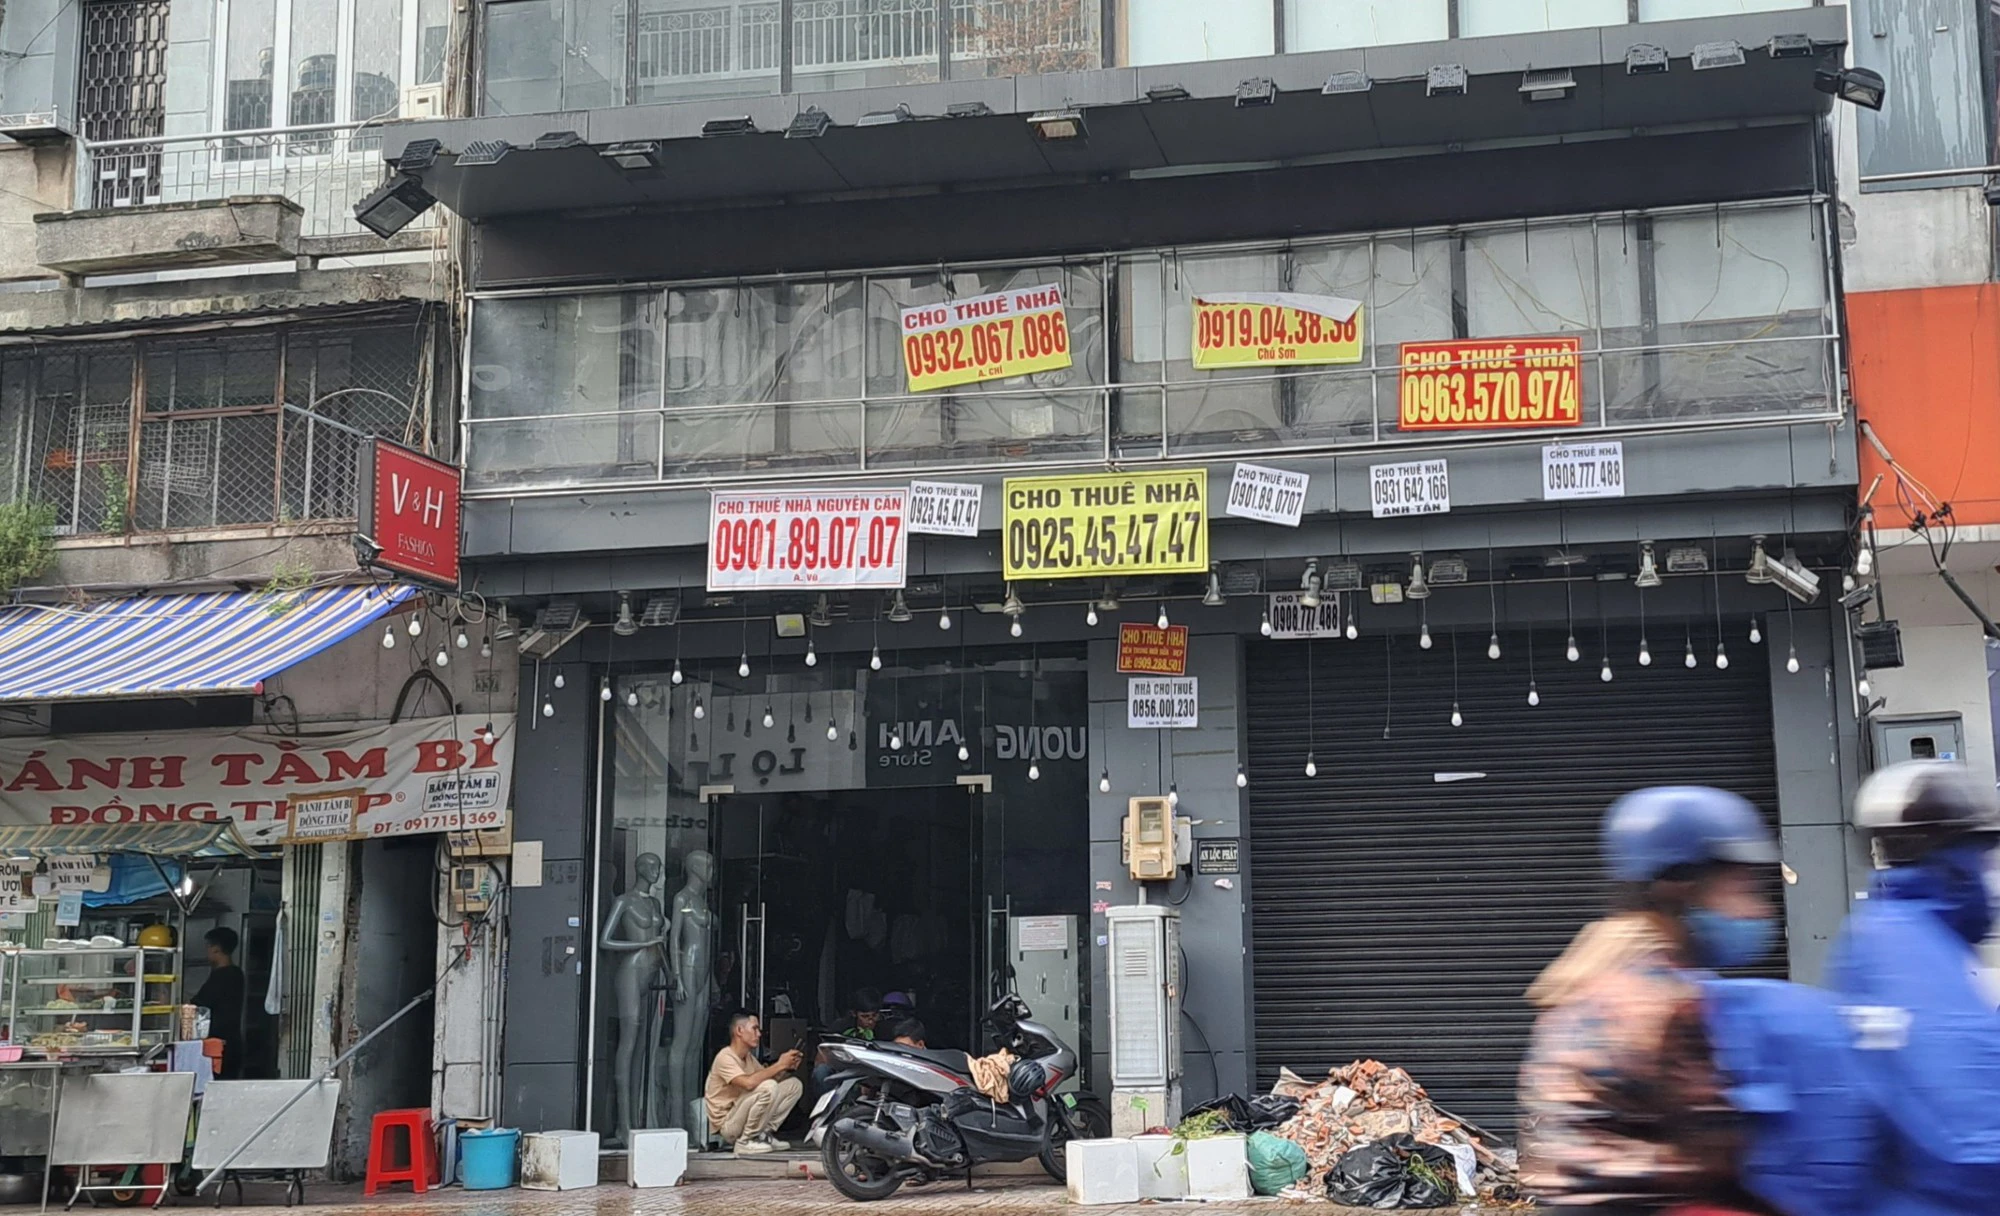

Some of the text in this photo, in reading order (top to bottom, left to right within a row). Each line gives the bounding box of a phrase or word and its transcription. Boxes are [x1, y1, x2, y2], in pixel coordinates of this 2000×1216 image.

[905, 285, 1062, 330] CHO THUÊ NHÀ
[906, 311, 1067, 377] 0932.067.086
[1278, 347, 1296, 359] Sơn
[1405, 343, 1575, 373] CHO THUÊ NHÀ
[1405, 370, 1576, 423] 0963.570.974
[1548, 445, 1619, 459] CHO THUÊ NHÀ
[1237, 468, 1303, 489] CHO THUÊ NHÀ
[1375, 462, 1445, 478] CHO THUÊ NHÀ
[1548, 460, 1621, 490] 0908.777.488
[392, 472, 444, 529] V & H
[718, 494, 902, 514] CHO THUÊ NHÀ NGUYÊN CĂN
[915, 485, 978, 498] CHO THUÊ NHÀ
[1009, 478, 1200, 510] CHO THUÊ NHÀ
[1231, 481, 1303, 517] 0901.89.0707
[1375, 475, 1447, 505] 0931 642 166
[910, 496, 979, 528] 0925.45.47.47
[397, 532, 435, 558] FASHION
[715, 515, 901, 571] 0901.89.07.07
[1009, 511, 1201, 570] 0925.45.47.47
[1276, 595, 1293, 603] CHO
[1122, 629, 1140, 644] CHO
[1134, 681, 1193, 695] NHÀ CHO THUÊ
[1133, 698, 1195, 718] 0856.001.230
[0, 750, 188, 792] ÁNH
[50, 795, 219, 825] ĐỒNG
